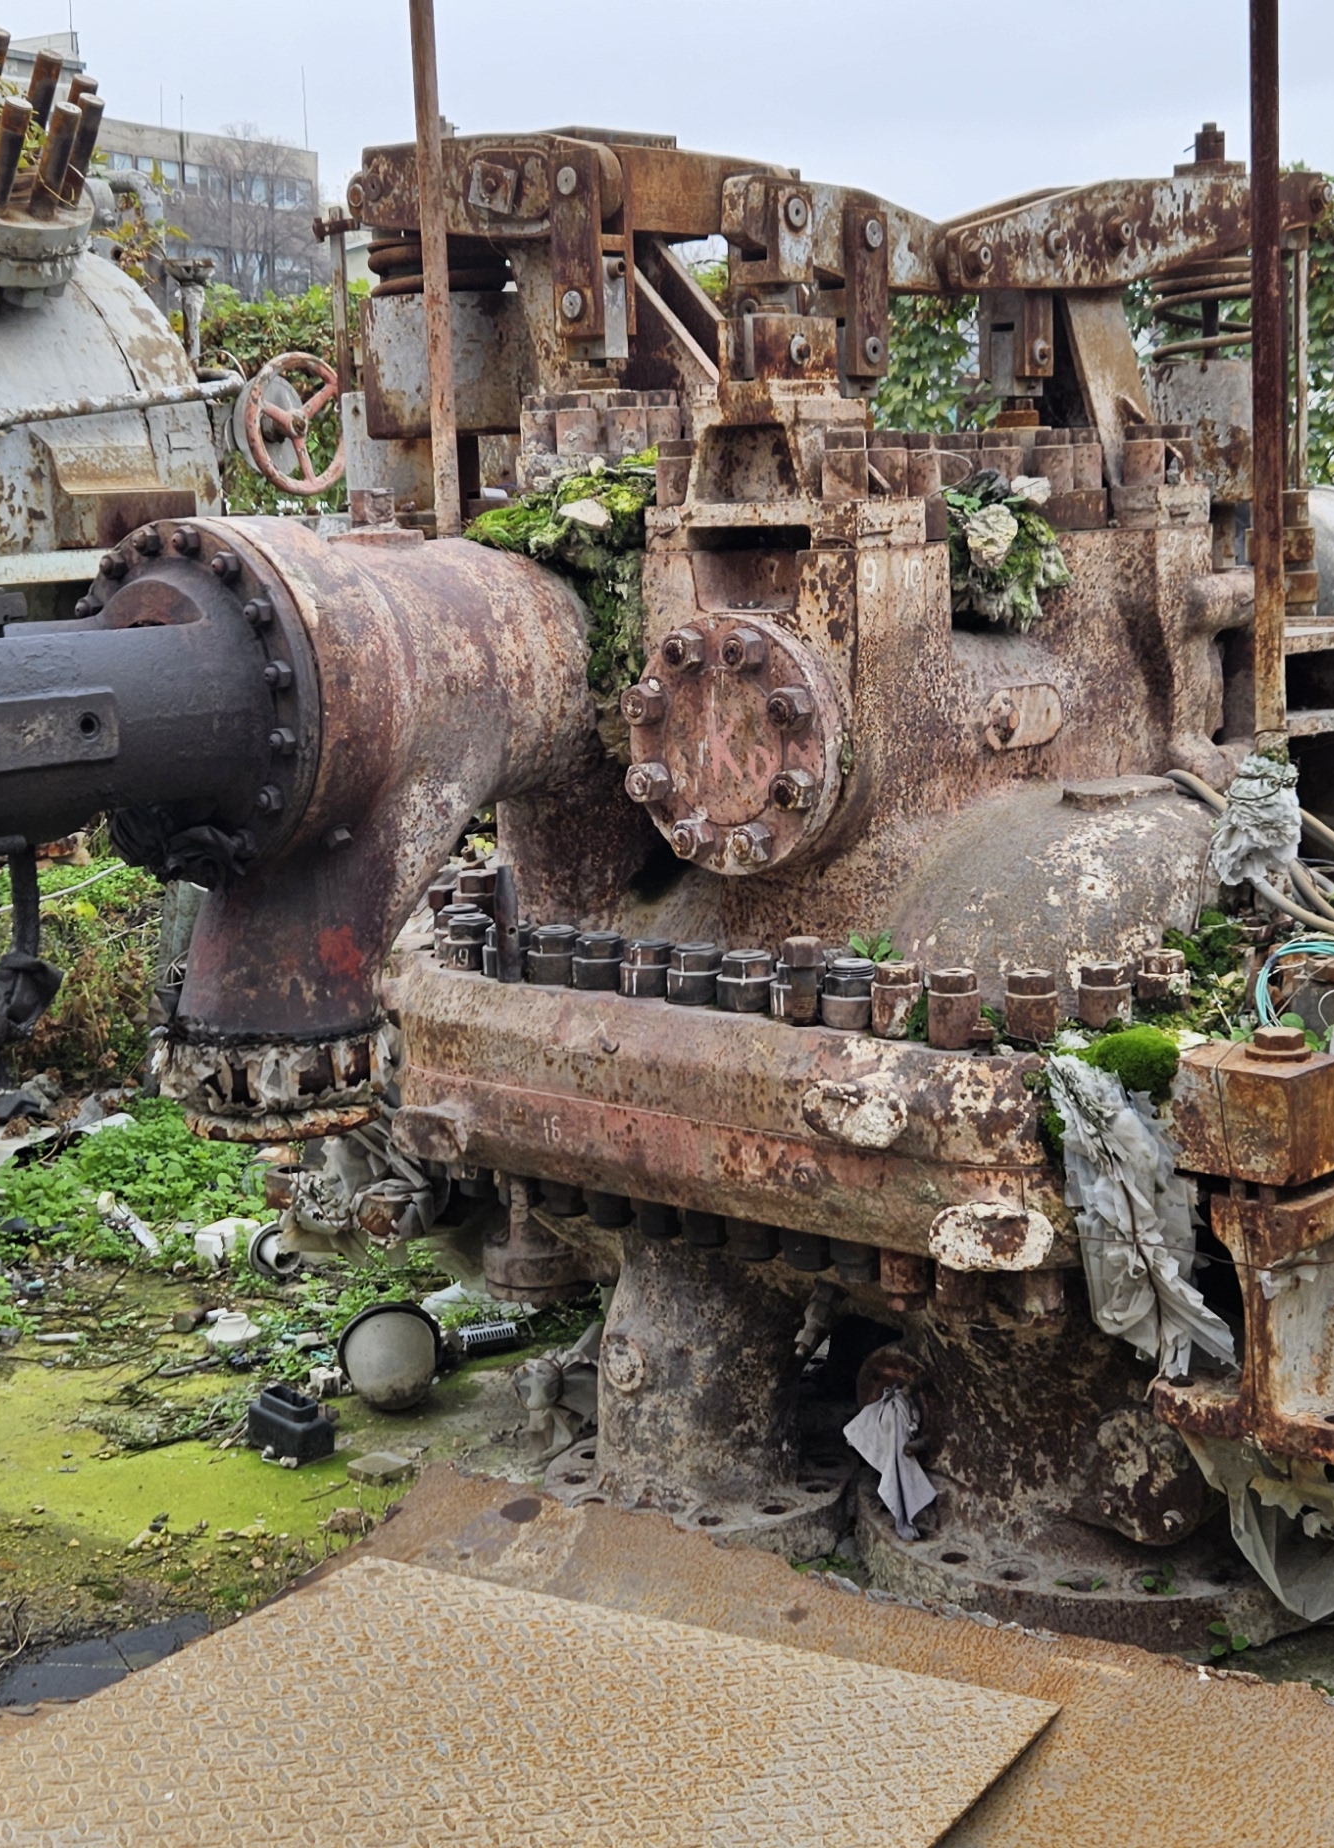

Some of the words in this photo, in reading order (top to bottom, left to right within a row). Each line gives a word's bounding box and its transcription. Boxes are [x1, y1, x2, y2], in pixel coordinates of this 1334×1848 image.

[863, 558, 878, 593] 9
[902, 557, 923, 591] 10
[451, 946, 470, 968] 19
[542, 1113, 563, 1146] 16
